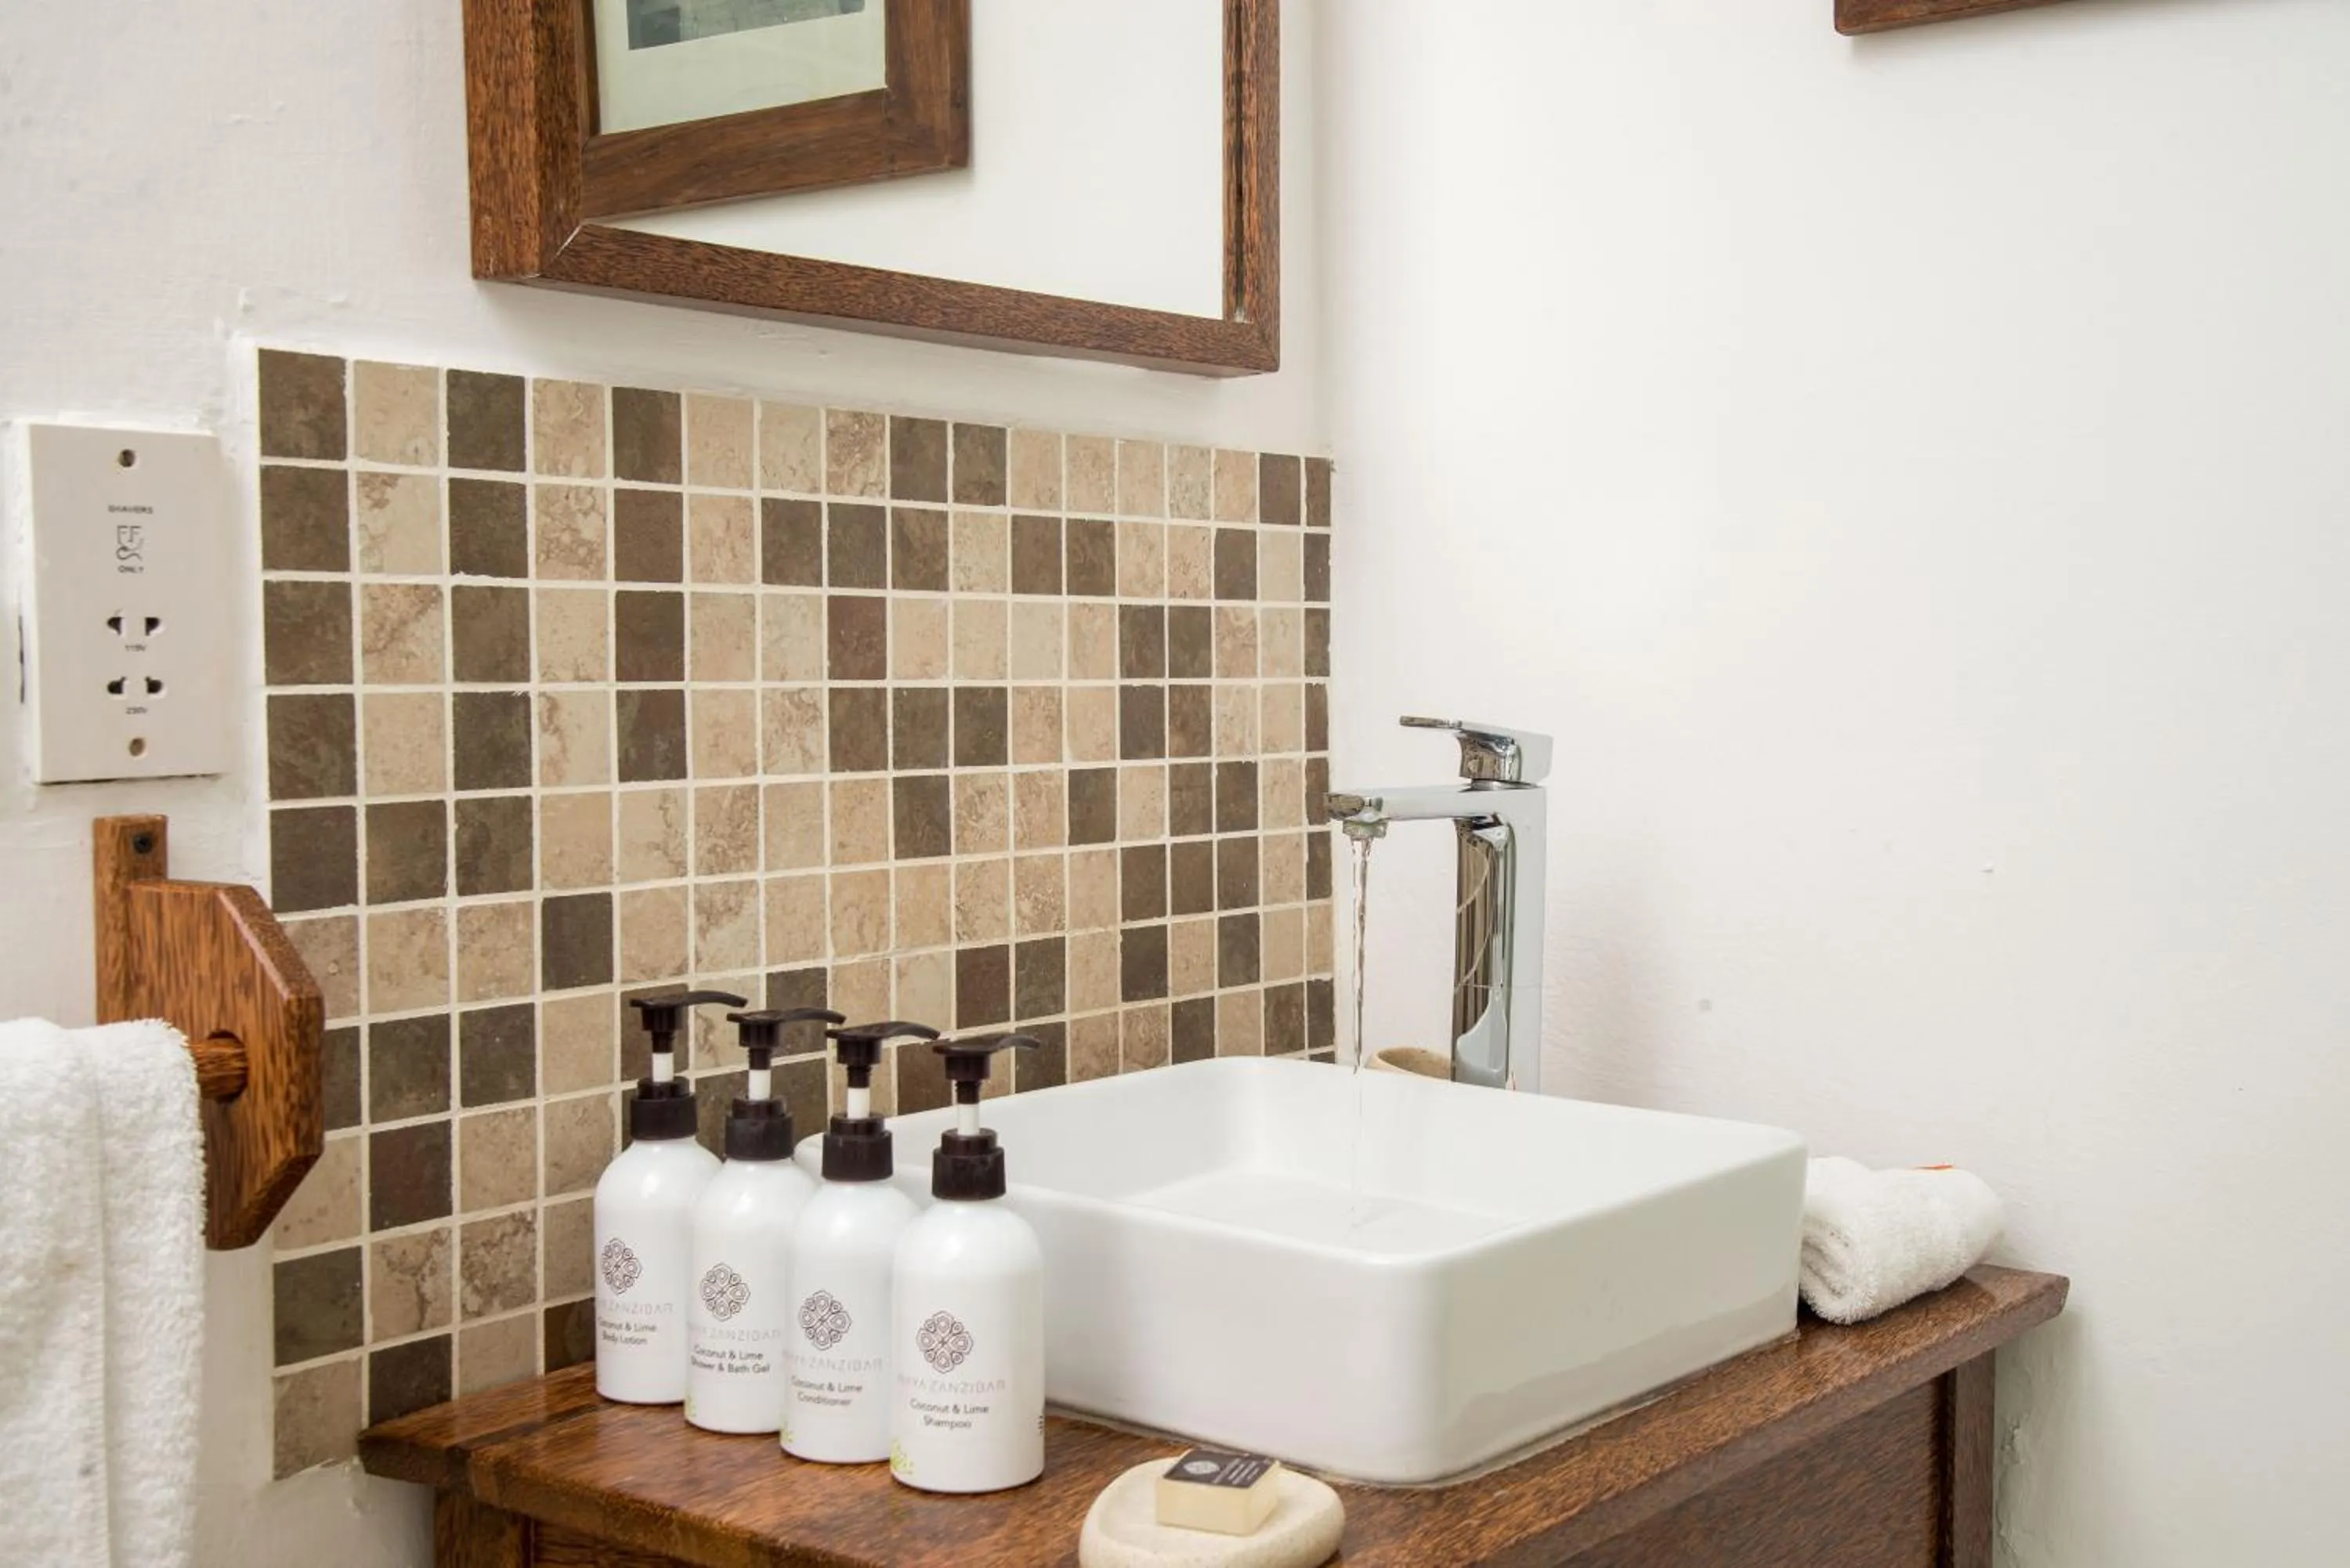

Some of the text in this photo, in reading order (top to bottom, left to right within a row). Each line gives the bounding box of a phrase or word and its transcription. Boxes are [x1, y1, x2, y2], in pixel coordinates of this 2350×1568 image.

[634, 1322, 657, 1332] Lime
[620, 1334, 649, 1345] Lotion
[728, 1349, 736, 1360] &
[739, 1349, 764, 1360] Lime
[718, 1362, 725, 1371] &
[727, 1362, 750, 1373] Bath
[752, 1363, 771, 1374] Gel
[827, 1381, 835, 1392] &
[837, 1382, 863, 1393] Lime
[797, 1390, 853, 1407] Conditioner
[909, 1397, 990, 1414] Coconut & Lime
[922, 1414, 973, 1431] Shampoo
